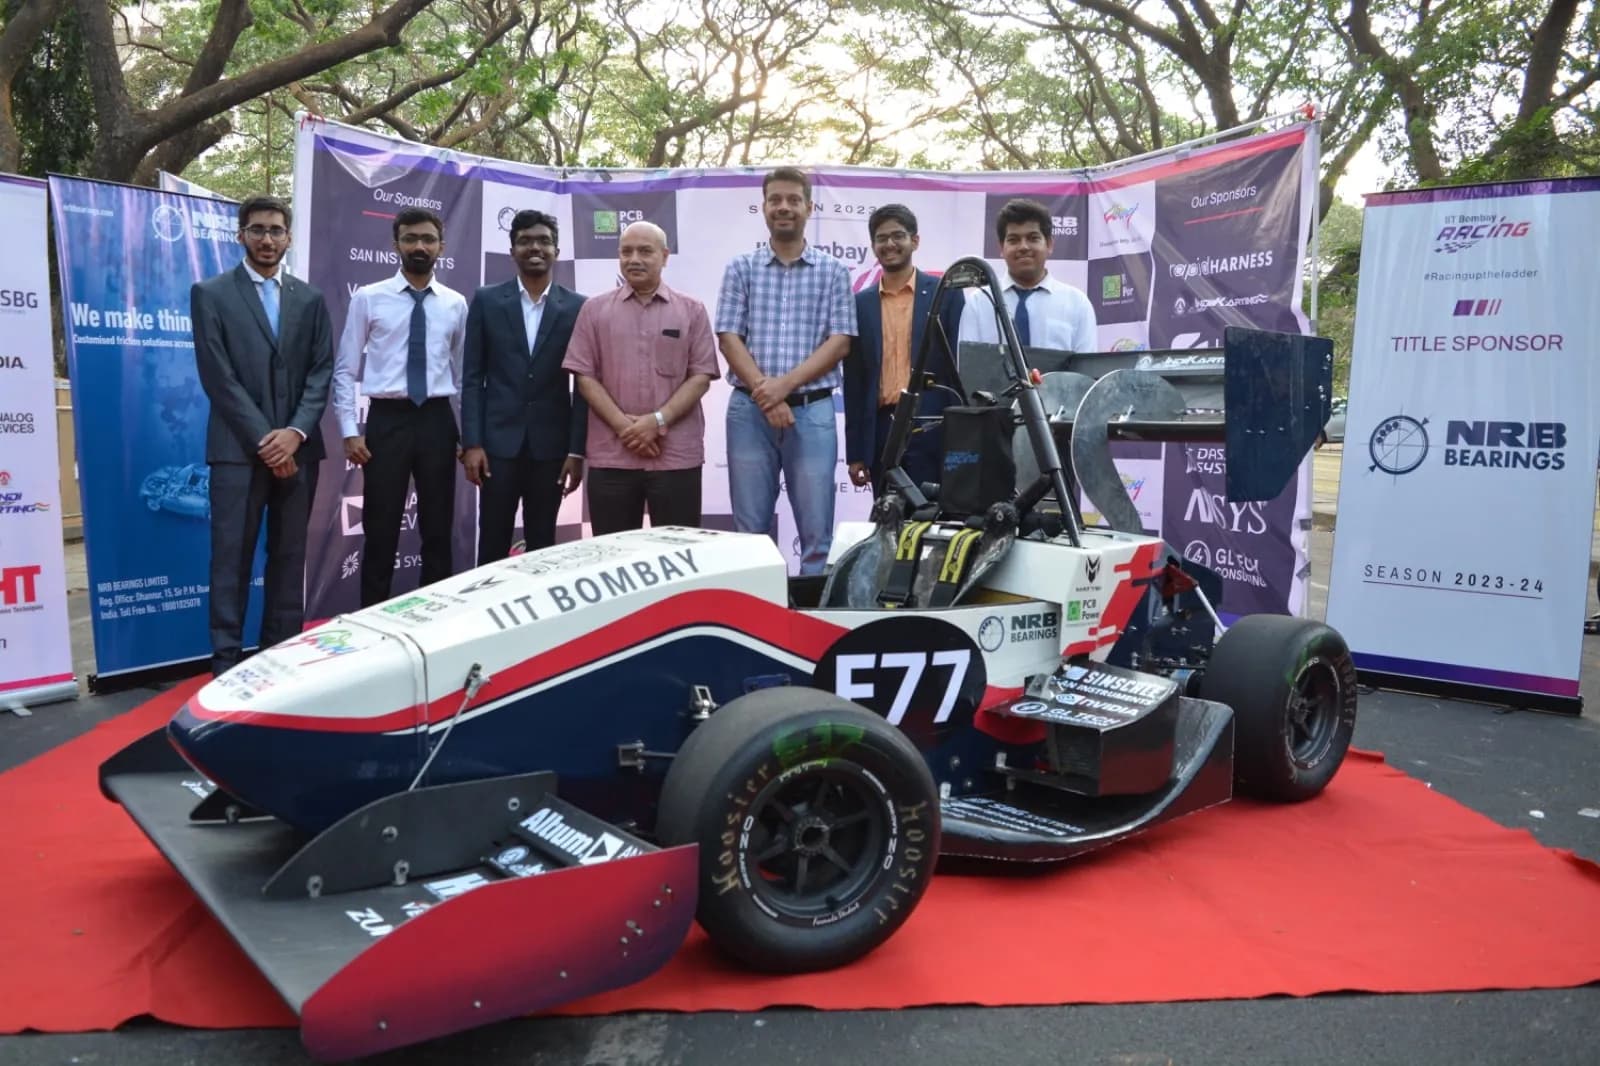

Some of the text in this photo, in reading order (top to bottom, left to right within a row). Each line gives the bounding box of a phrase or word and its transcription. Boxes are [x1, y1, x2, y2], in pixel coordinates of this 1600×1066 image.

[374, 188, 442, 211] Our Sponsors
[1191, 185, 1256, 209] Our Sponsors
[620, 210, 643, 221] PCB
[1459, 214, 1496, 223] Bombay
[350, 247, 373, 262] SAN
[0, 290, 38, 308] SBG
[71, 302, 100, 328] We
[104, 307, 155, 330] make
[1391, 334, 1564, 352] TITLE SPONSOR
[1446, 420, 1567, 449] NRB
[1444, 449, 1566, 470] BEARINGS
[1216, 548, 1234, 566] GL
[113, 579, 144, 591] BEARINGS
[144, 576, 168, 587] LIMITED
[1363, 564, 1543, 593] SEASON 2023-24
[486, 595, 540, 630] IIT
[547, 548, 701, 613] BOMBAY
[1010, 612, 1058, 632] NRB
[1010, 627, 1058, 643] BEARINGS
